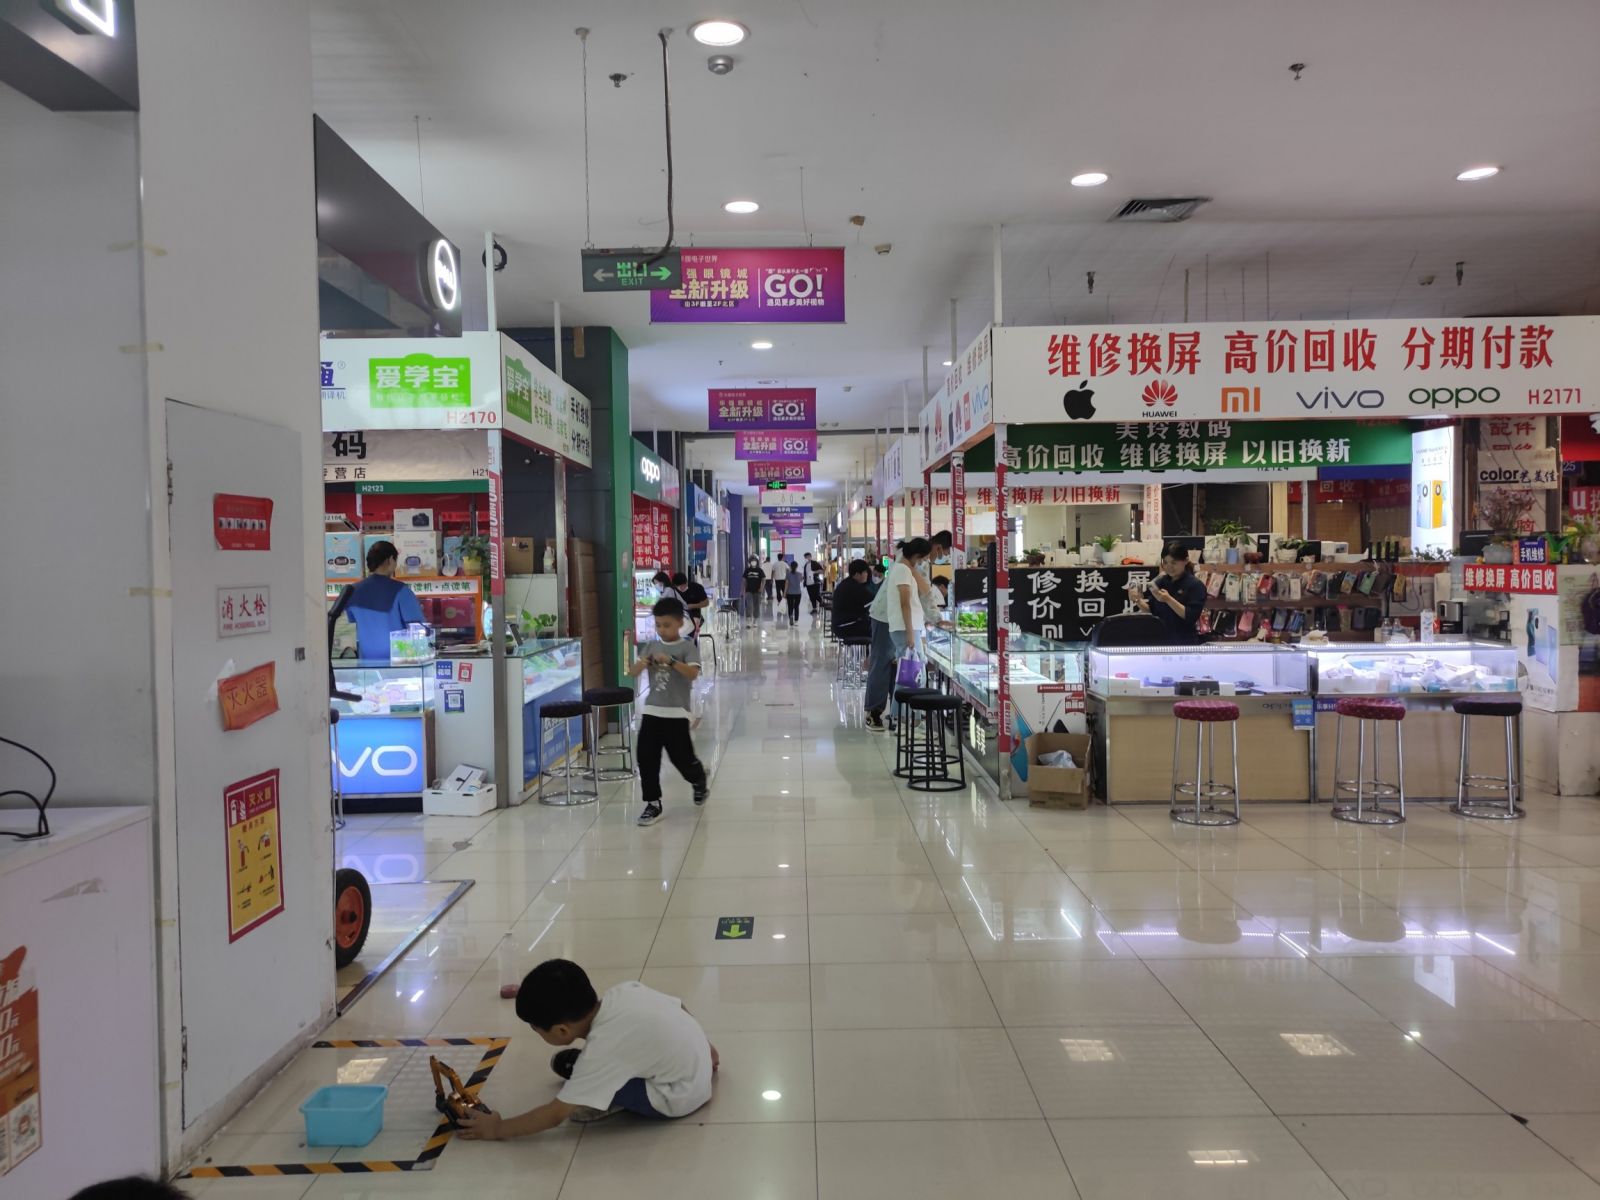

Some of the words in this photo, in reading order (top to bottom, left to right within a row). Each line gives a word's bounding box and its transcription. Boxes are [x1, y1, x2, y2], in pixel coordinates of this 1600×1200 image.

[621, 278, 644, 286] EXIT
[765, 274, 823, 298] GO!
[1048, 331, 1201, 377] 维修换屏
[1224, 327, 1377, 374] 高价回收
[1402, 324, 1554, 371] 分期付款
[375, 365, 459, 389] 爱学宝
[1296, 387, 1385, 409] vivo
[1408, 387, 1501, 409] oppo
[1528, 388, 1582, 405] H2171
[446, 410, 497, 424] H2170
[772, 402, 805, 416] GO!
[1142, 410, 1178, 418] HUAWEI
[783, 440, 809, 451] GO!
[1004, 443, 1105, 470] 高价回收
[1119, 440, 1228, 468] 维修换屏
[1241, 437, 1351, 465] 以旧换新
[640, 457, 661, 483] oppo
[1480, 466, 1519, 481] color
[362, 485, 384, 493] H2123
[1053, 484, 1121, 504] 以旧换新
[1465, 568, 1505, 588] 维修换屏
[1510, 568, 1555, 590] 高价回收
[221, 593, 267, 621] 消火栓
